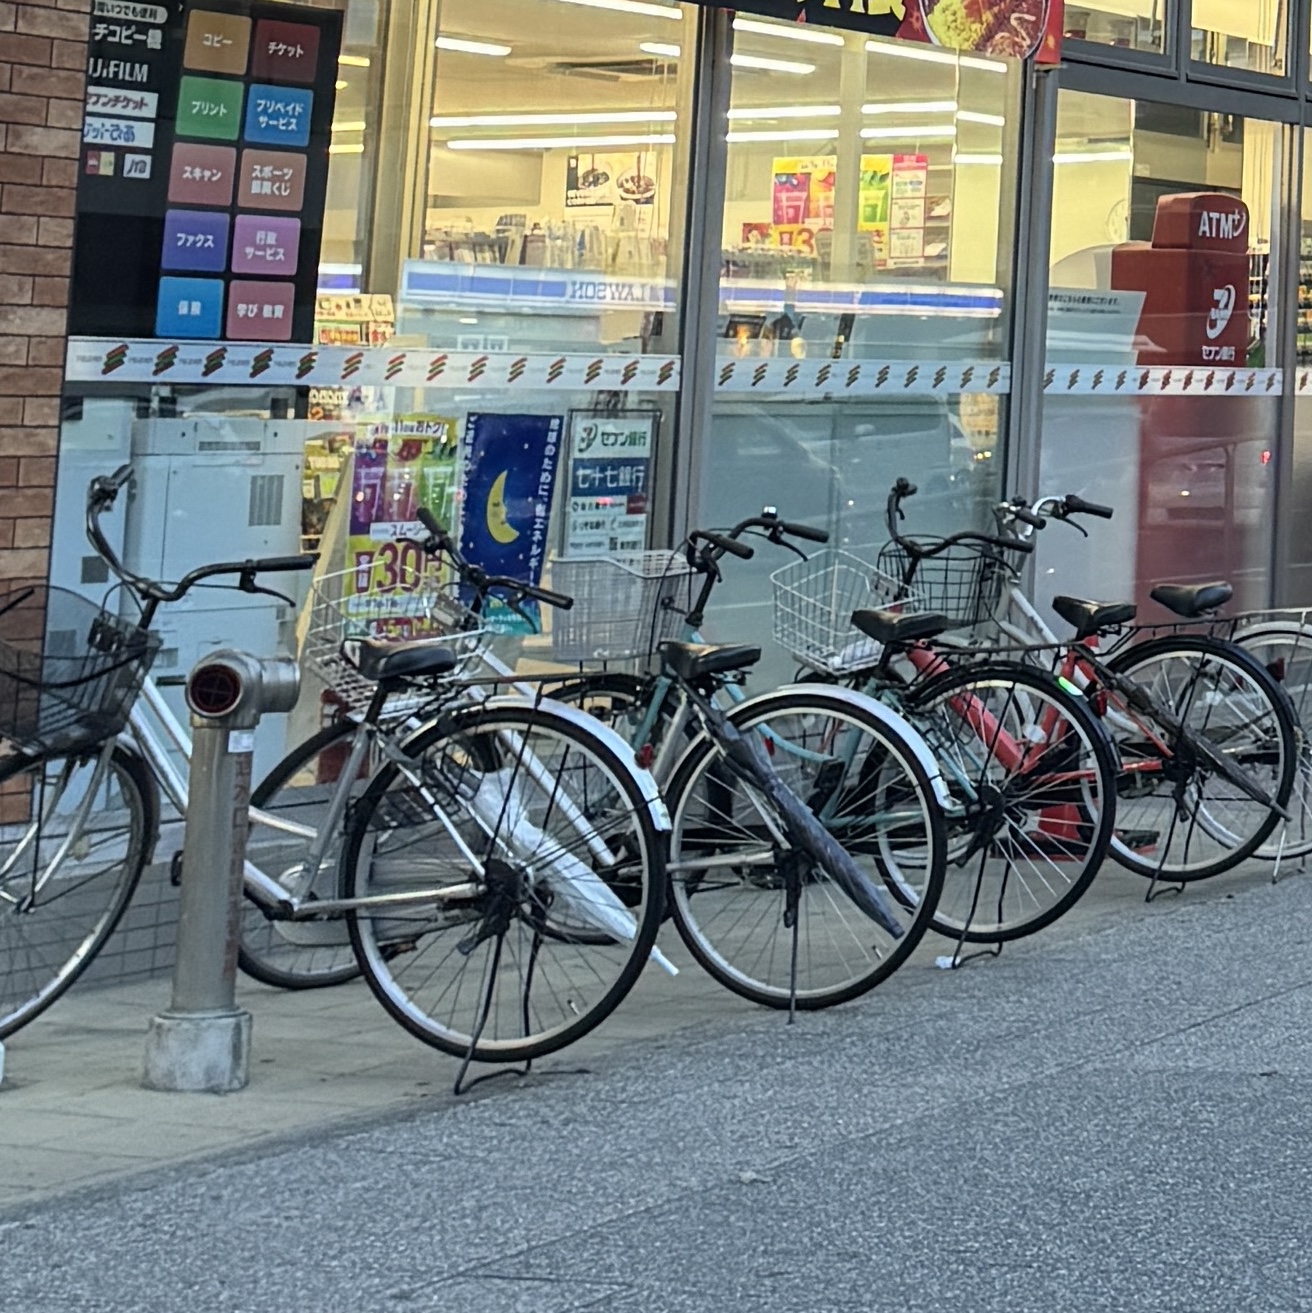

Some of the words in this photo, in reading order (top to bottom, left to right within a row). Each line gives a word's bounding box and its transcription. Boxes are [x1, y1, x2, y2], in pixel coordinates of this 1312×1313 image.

[203, 33, 233, 47] コピー
[268, 41, 304, 58] チケット
[191, 100, 228, 116] プリント
[256, 98, 304, 116] プリペイド
[258, 116, 299, 131] サービス
[182, 165, 222, 182] スキャン
[251, 164, 293, 178] スポーツ
[176, 232, 214, 248] ファクス
[244, 247, 285, 261] サービス
[575, 465, 646, 492] 七十七銀行
